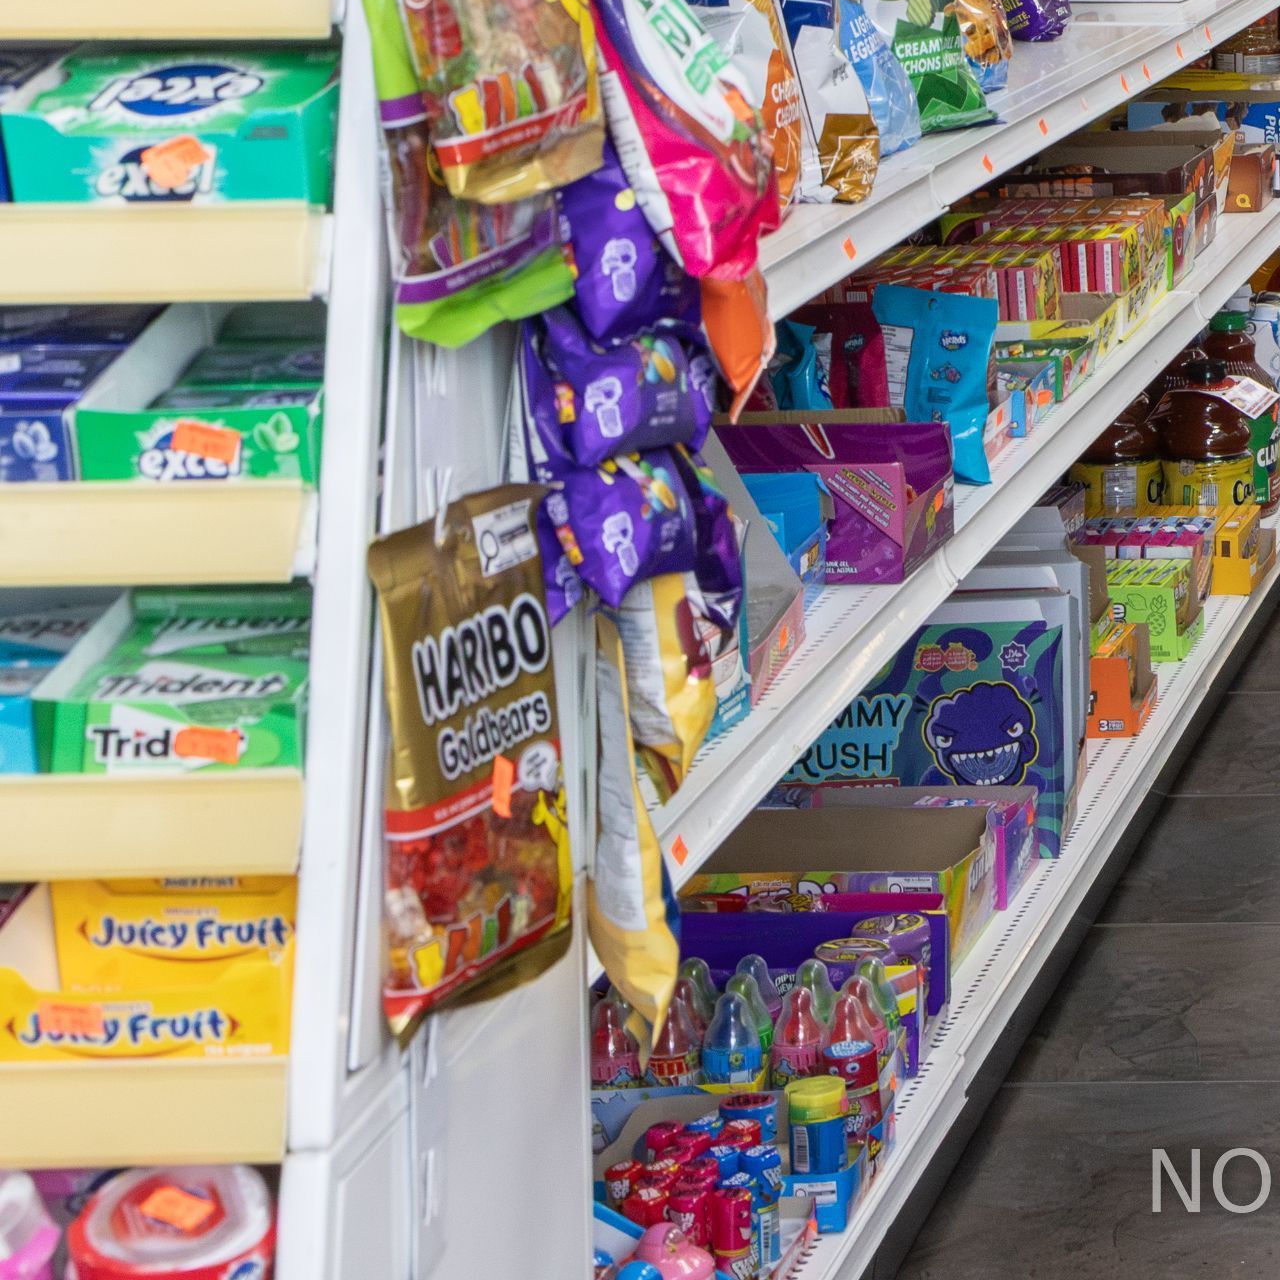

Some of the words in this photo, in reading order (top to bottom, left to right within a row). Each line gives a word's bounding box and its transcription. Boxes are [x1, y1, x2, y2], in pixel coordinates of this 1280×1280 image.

[91, 63, 265, 113] excel
[412, 594, 551, 725] HARIBO
[102, 671, 289, 699] Trident
[438, 691, 551, 781] Goldbears
[89, 916, 189, 950] Juicy
[196, 915, 291, 949] Fruit
[126, 1010, 226, 1042] Fruit
